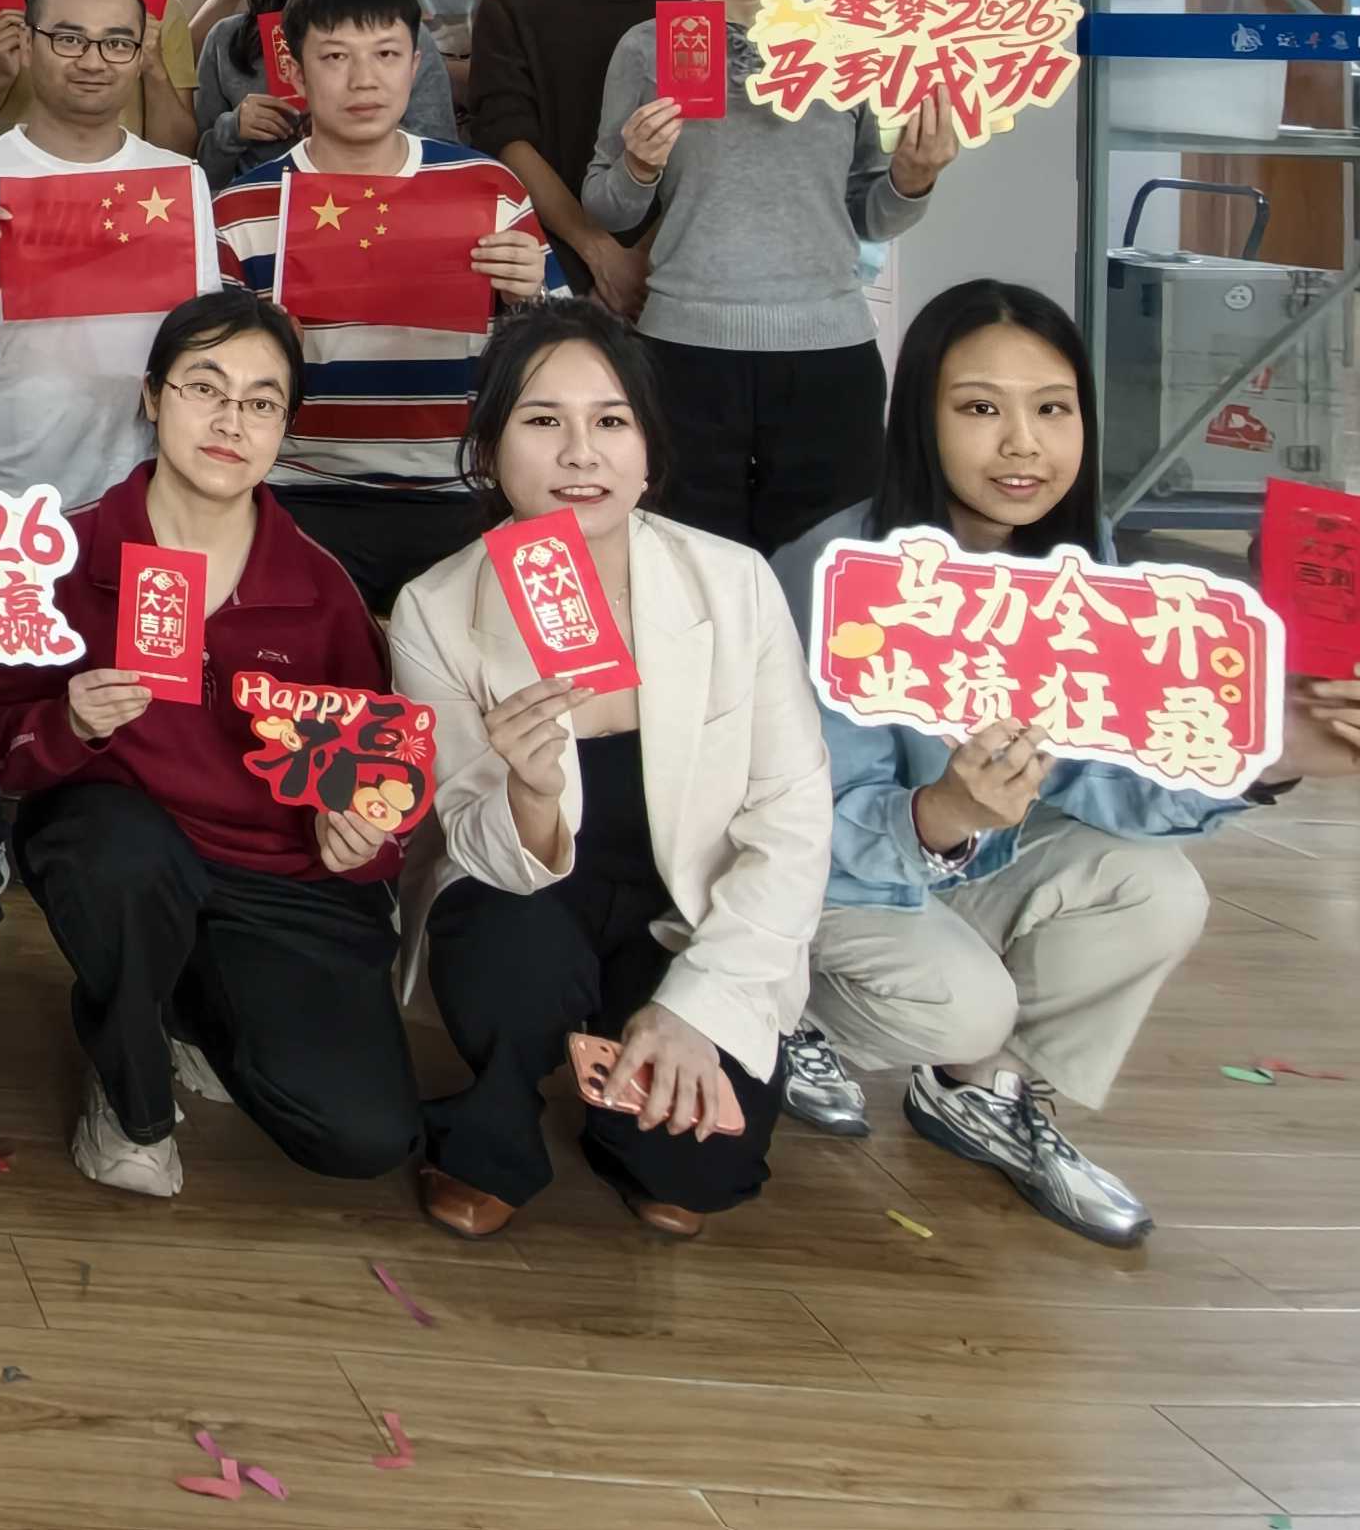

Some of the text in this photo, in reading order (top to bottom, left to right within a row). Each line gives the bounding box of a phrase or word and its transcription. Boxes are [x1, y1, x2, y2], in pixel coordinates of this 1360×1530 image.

[755, 37, 1072, 139] 马到成功
[868, 539, 1226, 680] 马力全开
[238, 675, 368, 725] Happy
